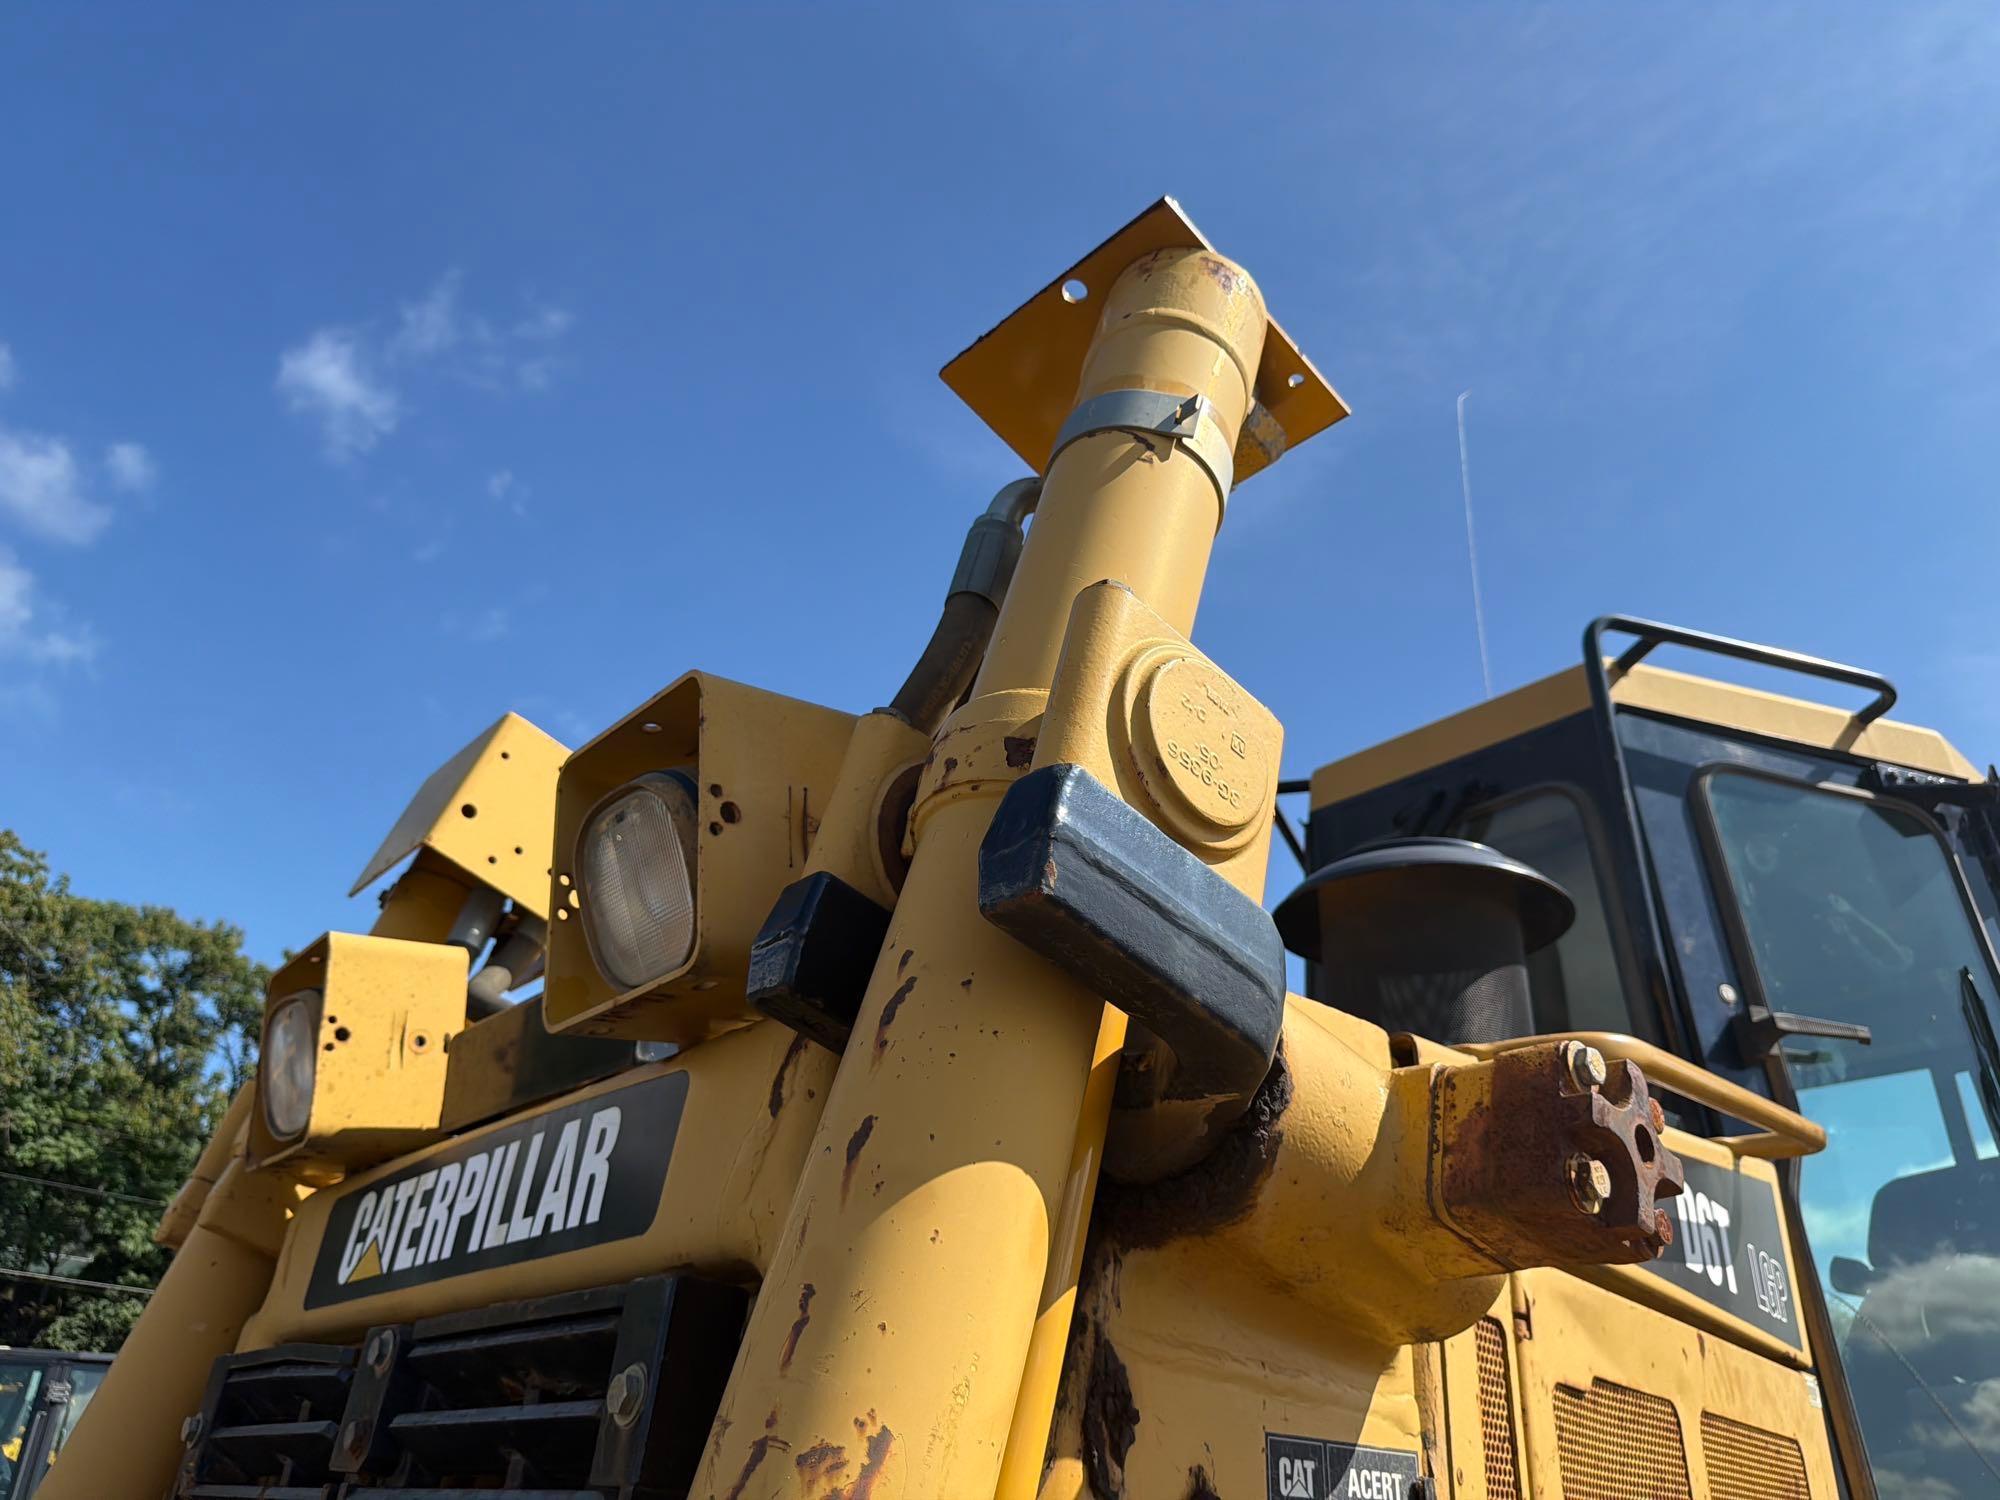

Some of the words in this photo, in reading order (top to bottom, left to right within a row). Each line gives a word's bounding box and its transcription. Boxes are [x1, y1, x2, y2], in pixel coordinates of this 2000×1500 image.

[337, 1106, 622, 1285] CATERPILLAR
[1675, 1181, 1738, 1295] D6T
[1746, 1243, 1788, 1323] LGP
[1278, 1456, 1316, 1499] CAT
[1348, 1468, 1402, 1500] ACERT
